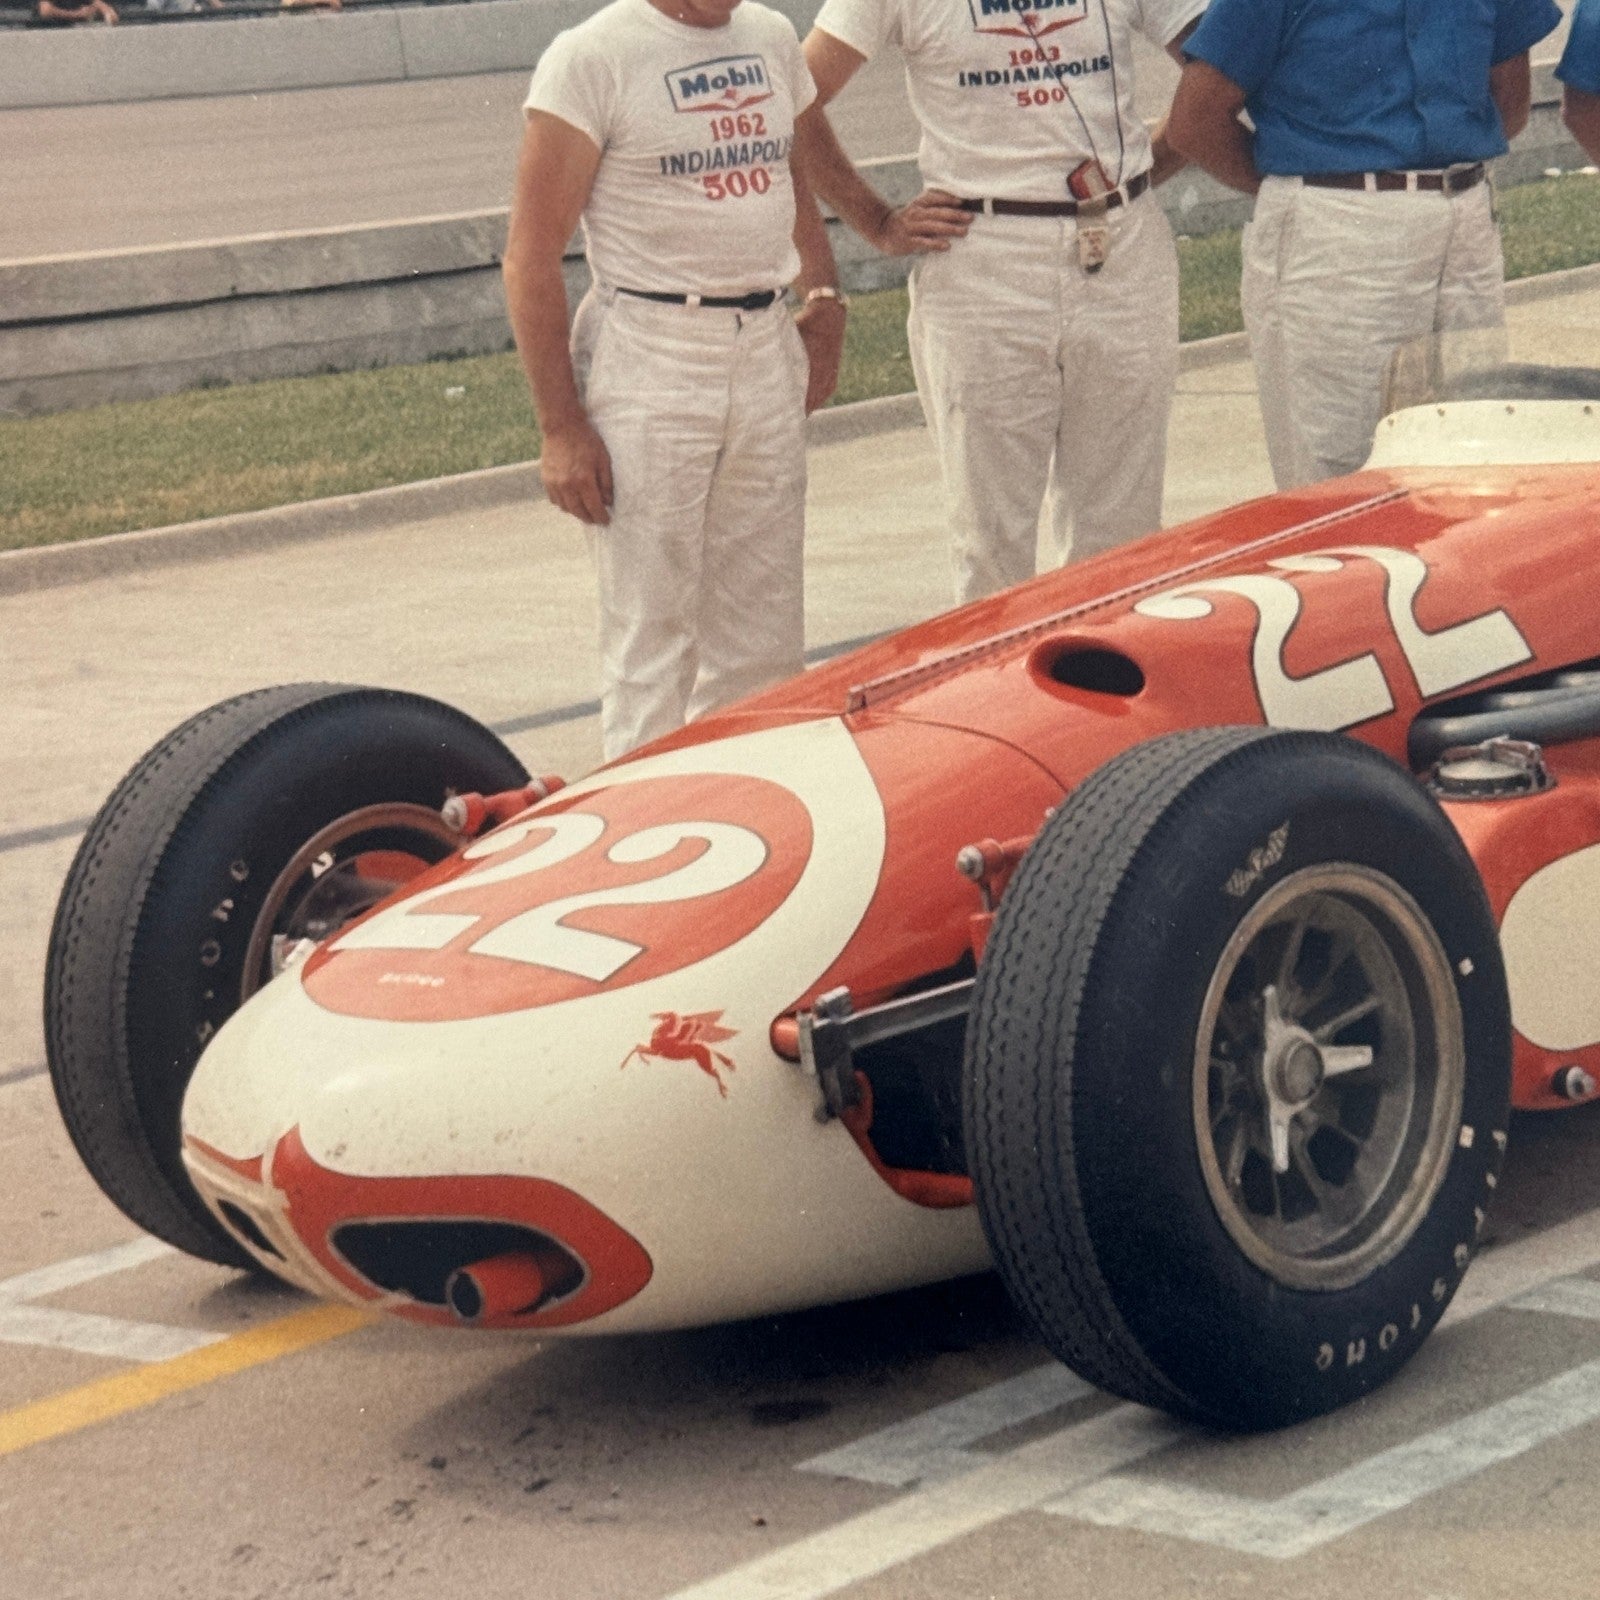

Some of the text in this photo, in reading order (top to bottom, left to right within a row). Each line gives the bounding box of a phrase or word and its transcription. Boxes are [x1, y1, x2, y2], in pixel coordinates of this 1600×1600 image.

[679, 63, 764, 99] Mobil
[959, 55, 1111, 87] INDIANAPOLIS
[709, 113, 767, 142] 1962
[1133, 545, 1537, 732] 22
[326, 812, 769, 983] 22
